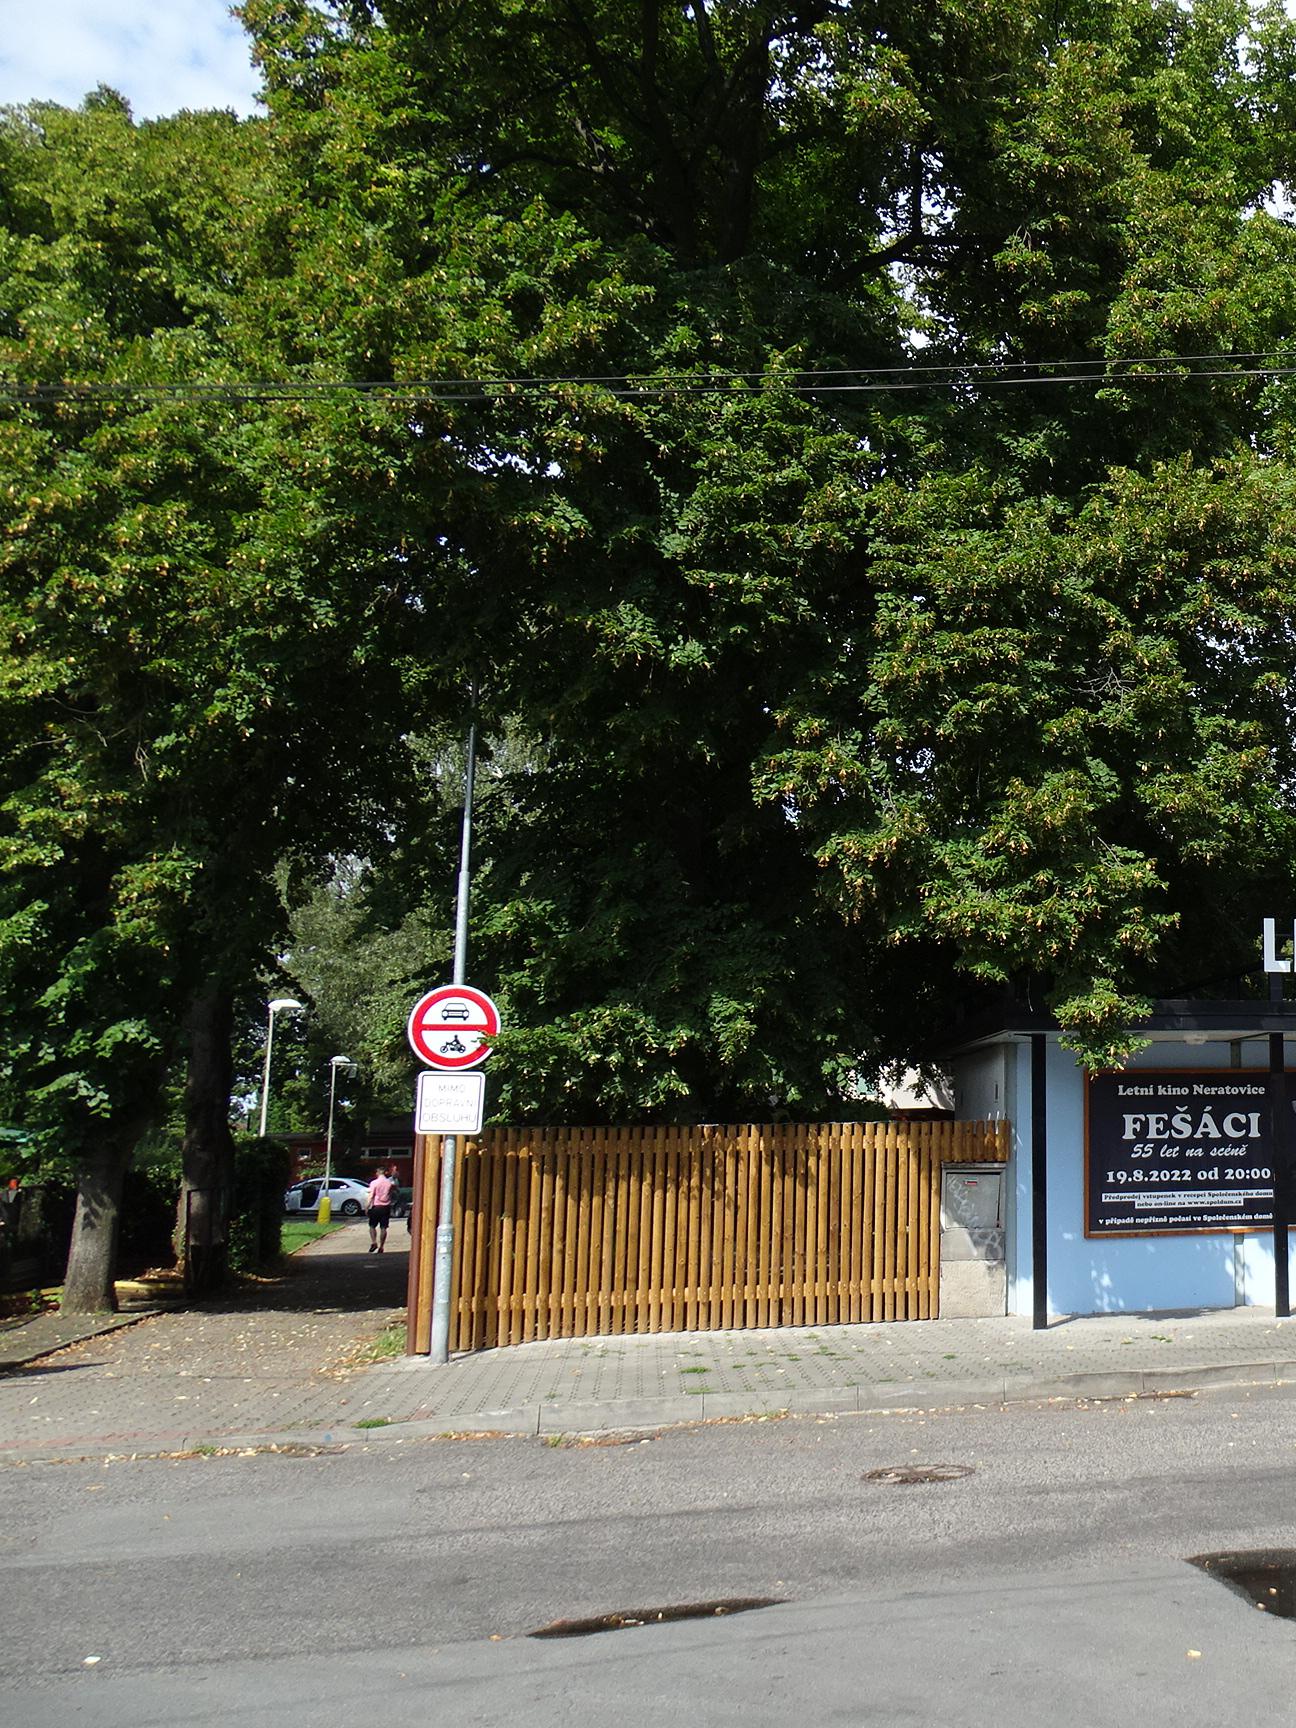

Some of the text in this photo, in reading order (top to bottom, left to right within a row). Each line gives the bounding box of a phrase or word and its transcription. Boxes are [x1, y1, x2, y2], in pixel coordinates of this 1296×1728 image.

[1118, 1084, 1266, 1096] Letní kino Neratovice
[1122, 1105, 1261, 1139] FEŠÁCI
[1131, 1143, 1248, 1158] 55 let na scéně
[1106, 1167, 1271, 1184] 19.8.2022 od 20:00
[1104, 1193, 1141, 1201] Předprodej
[1105, 1216, 1134, 1226] případě
[1135, 1216, 1168, 1224] nepřízně
[1169, 1215, 1192, 1224] počasí
